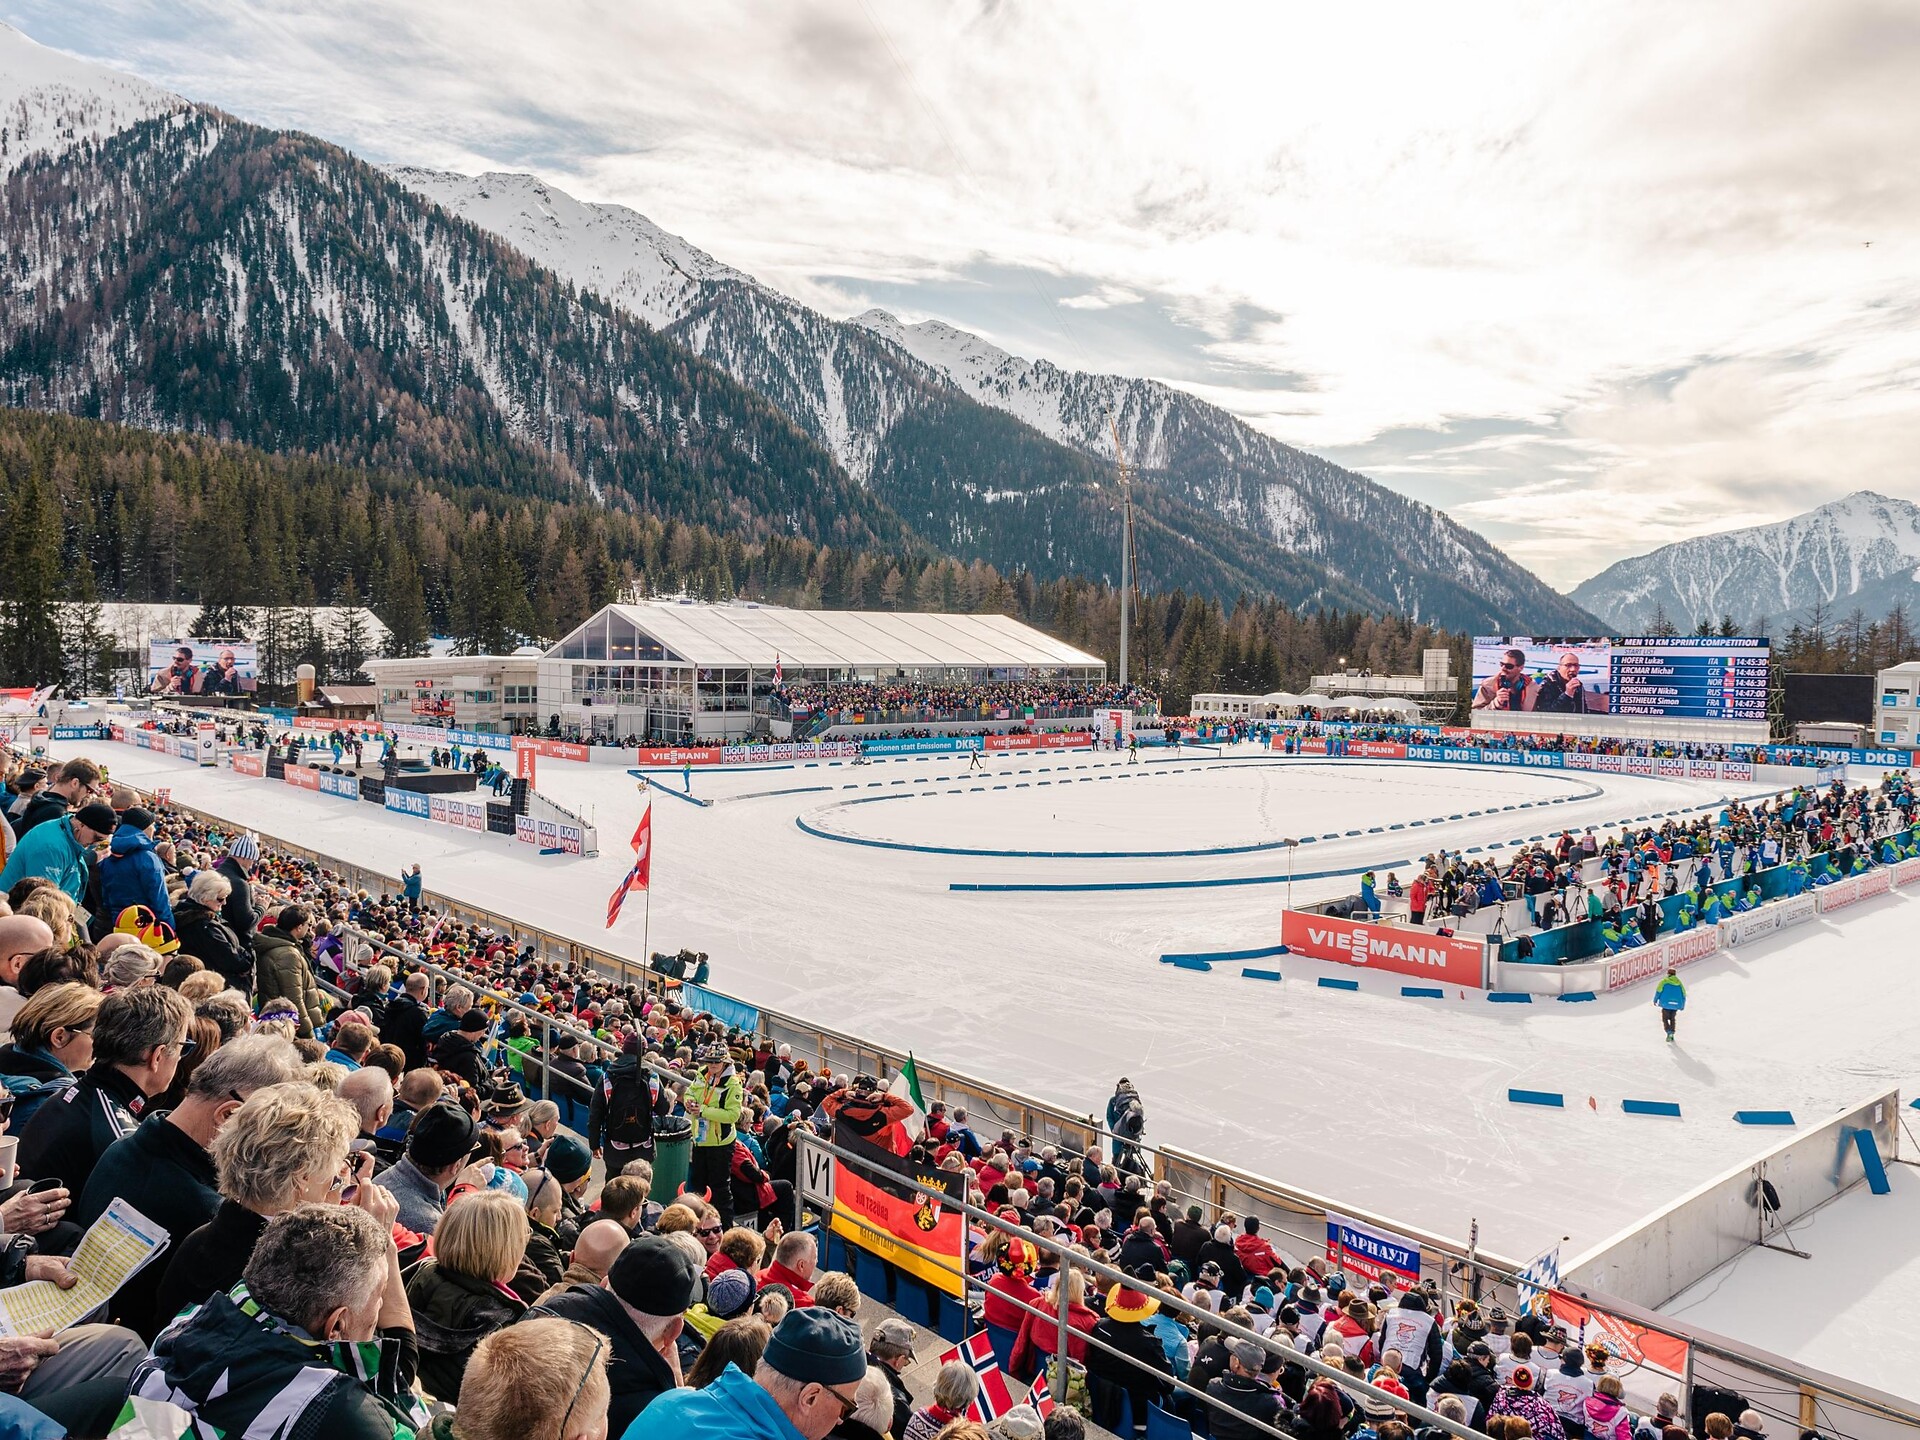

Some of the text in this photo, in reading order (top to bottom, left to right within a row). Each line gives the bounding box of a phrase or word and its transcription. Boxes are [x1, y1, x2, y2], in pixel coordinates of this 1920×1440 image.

[1701, 639, 1759, 647] COMPETITION
[1645, 657, 1664, 665] Lukas
[1736, 658, 1767, 666] 14:45:30
[1651, 667, 1674, 675] Michal
[1735, 679, 1766, 687] 14:46:30
[1658, 687, 1678, 695] Nikita
[1620, 696, 1656, 704] DESTHIEUX
[1657, 697, 1679, 705] Simon
[1734, 700, 1765, 708] 14:47:30
[1620, 706, 1648, 714] SEPPALA
[1649, 707, 1664, 715] Tero
[1706, 709, 1717, 717] FIN
[1734, 711, 1765, 719] 14:48:00
[56, 728, 74, 738] DKB
[917, 742, 951, 750] Emissionen
[955, 740, 974, 749] DKB
[993, 737, 1031, 749] VIESSMANN
[1048, 734, 1084, 746] VIESSMANN
[725, 746, 745, 755] LIQUI
[750, 745, 769, 754] LIQUI
[773, 744, 793, 753] LIQUI
[797, 743, 816, 752] LIQUI
[819, 743, 838, 751] LIQUI
[1347, 743, 1395, 756] VIESSMANN
[651, 750, 709, 764] VIESSMANN
[725, 754, 745, 763] MOLY
[750, 753, 769, 762] MOLY
[773, 752, 793, 760] MOLY
[797, 751, 816, 759] MOLY
[819, 750, 838, 758] MOLY
[1408, 747, 1470, 761] DKB DKB
[1484, 751, 1552, 766] DKB DKB
[1569, 755, 1592, 763] LIQUI
[1597, 756, 1621, 764] LIQUI
[1821, 750, 1850, 763] DKB
[1865, 752, 1897, 765] DKB
[1598, 764, 1621, 772] MOLY
[1627, 758, 1652, 767] LIQUI
[1658, 760, 1684, 769] LIQUI
[1690, 761, 1716, 770] LIQUI
[1723, 763, 1750, 772] LIQUI
[1627, 766, 1652, 774] MOLY
[1659, 768, 1684, 776] MOLY
[1690, 769, 1716, 778] MOLY
[1723, 771, 1751, 781] MOLY
[320, 775, 352, 793] DKB DKB
[386, 791, 422, 814] DKB DKB
[432, 797, 446, 810] LIQUI
[449, 801, 464, 813] LIQUI
[432, 809, 446, 821] MOLY
[466, 804, 482, 817] LIQUI
[449, 813, 464, 825] MOLY
[466, 817, 482, 829] MOLY
[517, 817, 535, 831] LIQUI
[539, 821, 556, 835] LIQUI
[561, 826, 580, 841] LIQUI
[518, 830, 535, 843] MOLY
[539, 835, 556, 848] MOLY
[561, 840, 580, 854] MOLY
[1307, 927, 1447, 967] VIESSMANN
[1668, 931, 1716, 967] BAUHAUS
[1609, 948, 1663, 988] BAUHAUS
[807, 1148, 830, 1197] V1
[1342, 1228, 1409, 1266] БАРНАУЛ
